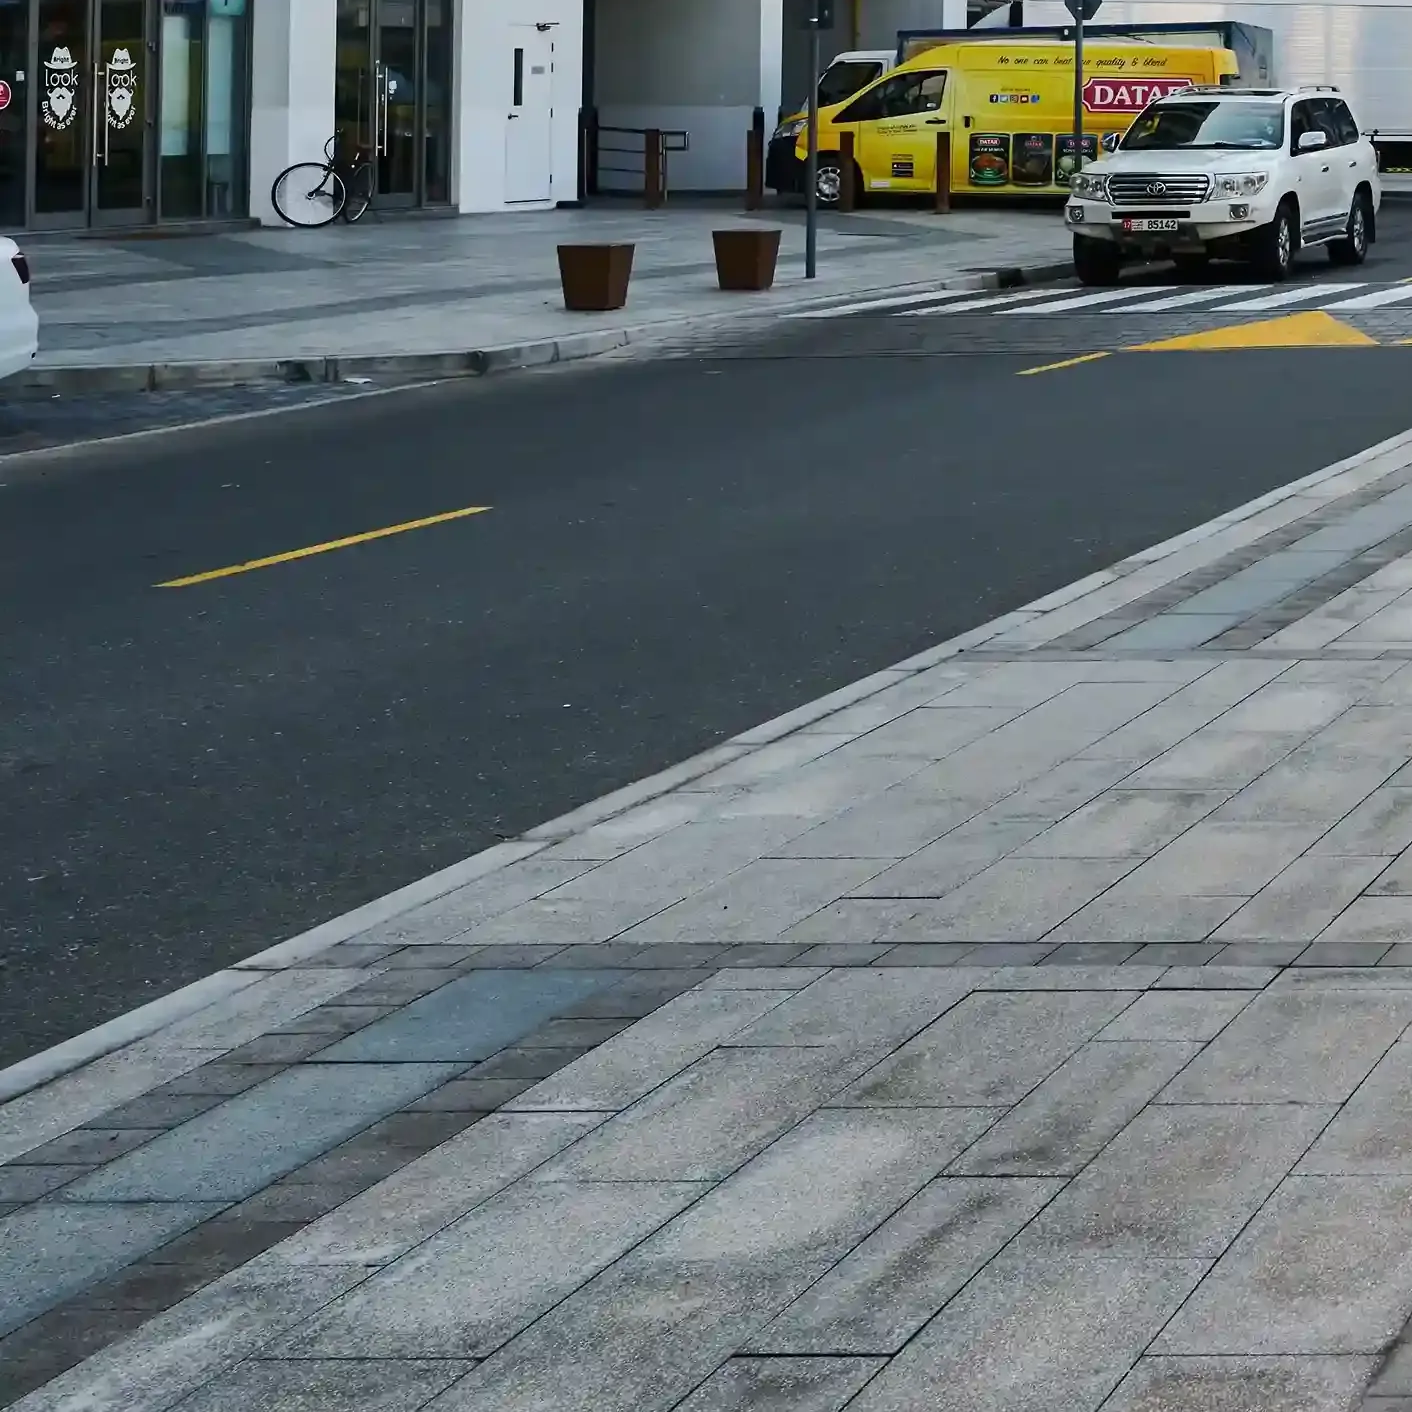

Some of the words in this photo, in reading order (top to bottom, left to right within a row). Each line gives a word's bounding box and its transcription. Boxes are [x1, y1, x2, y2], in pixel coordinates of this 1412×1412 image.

[997, 55, 1010, 65] No
[1033, 57, 1049, 65] can
[1096, 56, 1126, 69] quality
[1143, 56, 1168, 67] blend
[45, 69, 78, 86] look
[42, 101, 56, 129] Bright
[65, 104, 77, 126] ever
[1147, 219, 1177, 229] 85142
